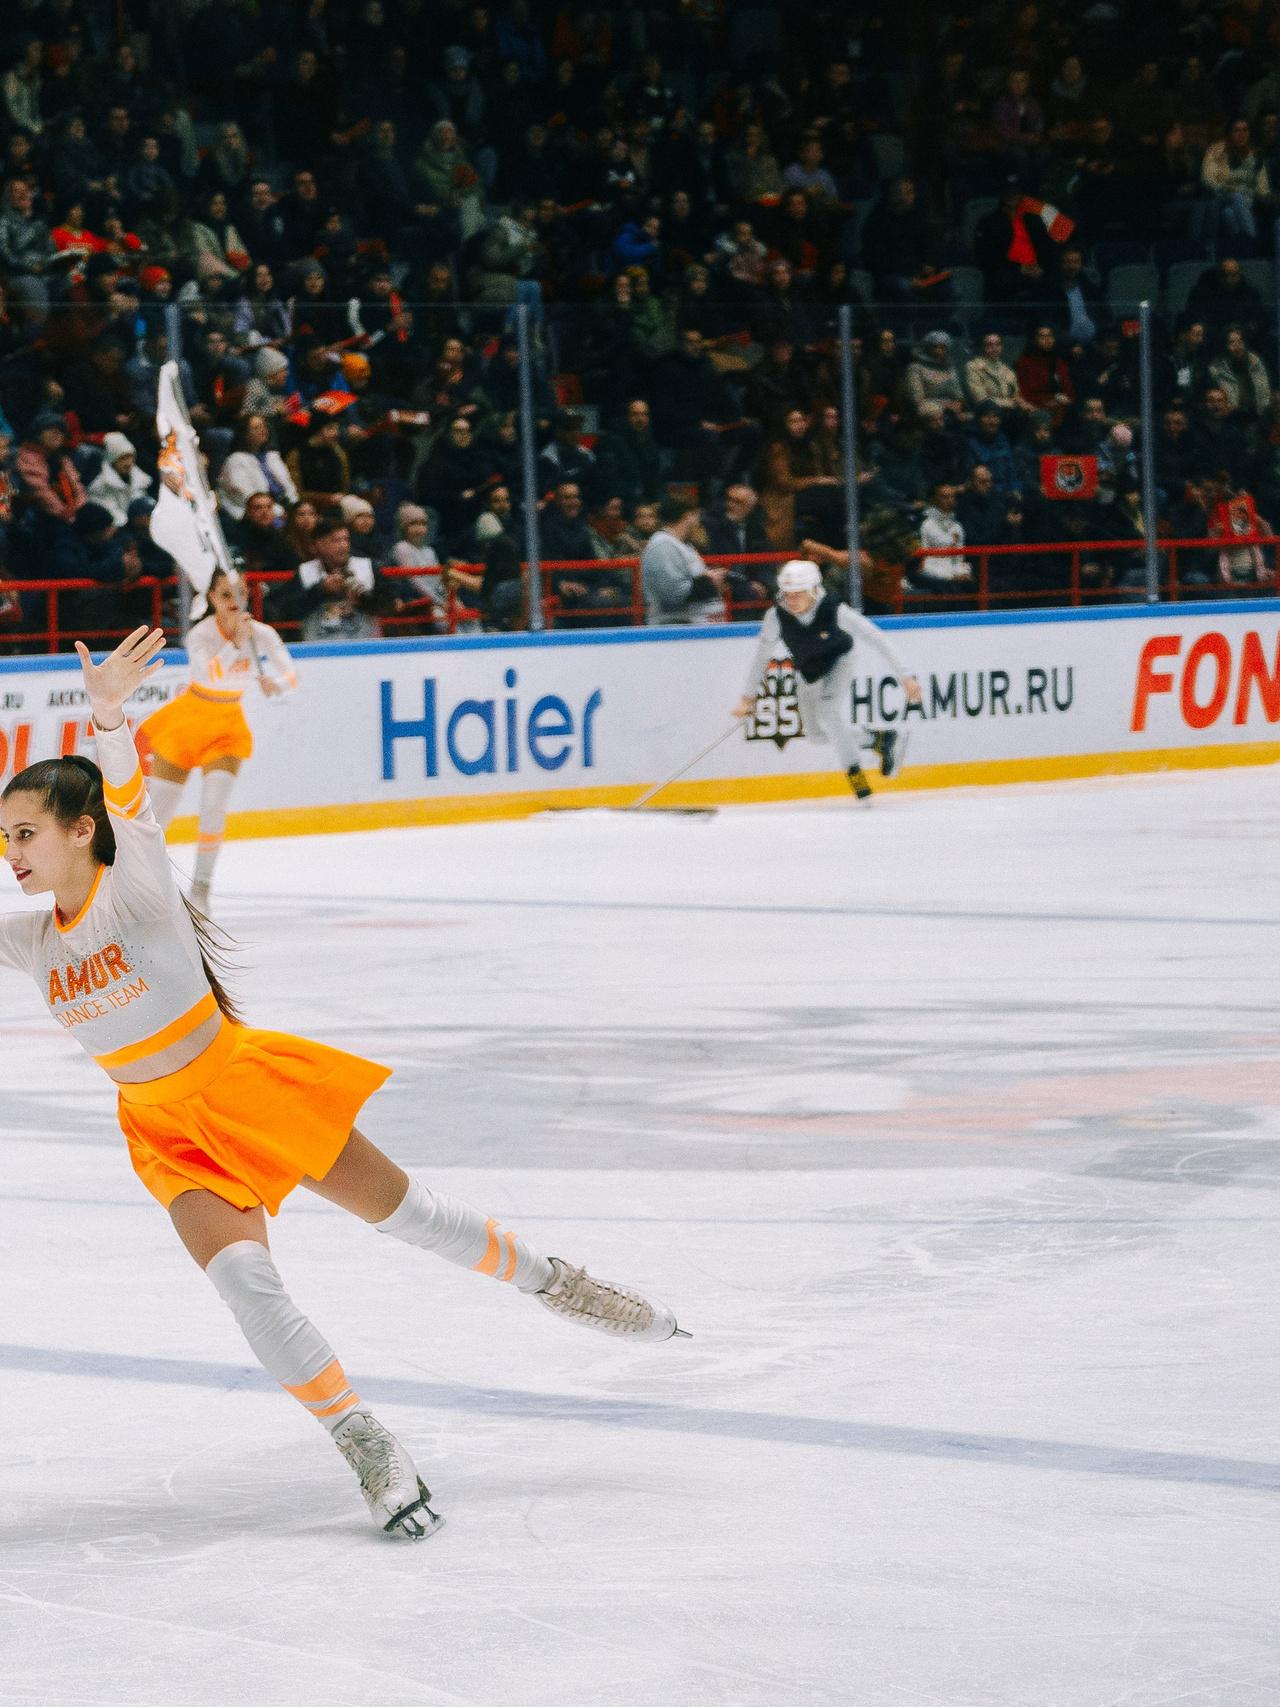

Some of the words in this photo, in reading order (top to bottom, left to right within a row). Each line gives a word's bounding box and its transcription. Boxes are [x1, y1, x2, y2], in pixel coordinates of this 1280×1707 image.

[380, 667, 602, 780] Haier
[49, 943, 133, 1005] AMUR
[55, 1000, 108, 1028] DANCE
[104, 977, 150, 1009] TEAM
